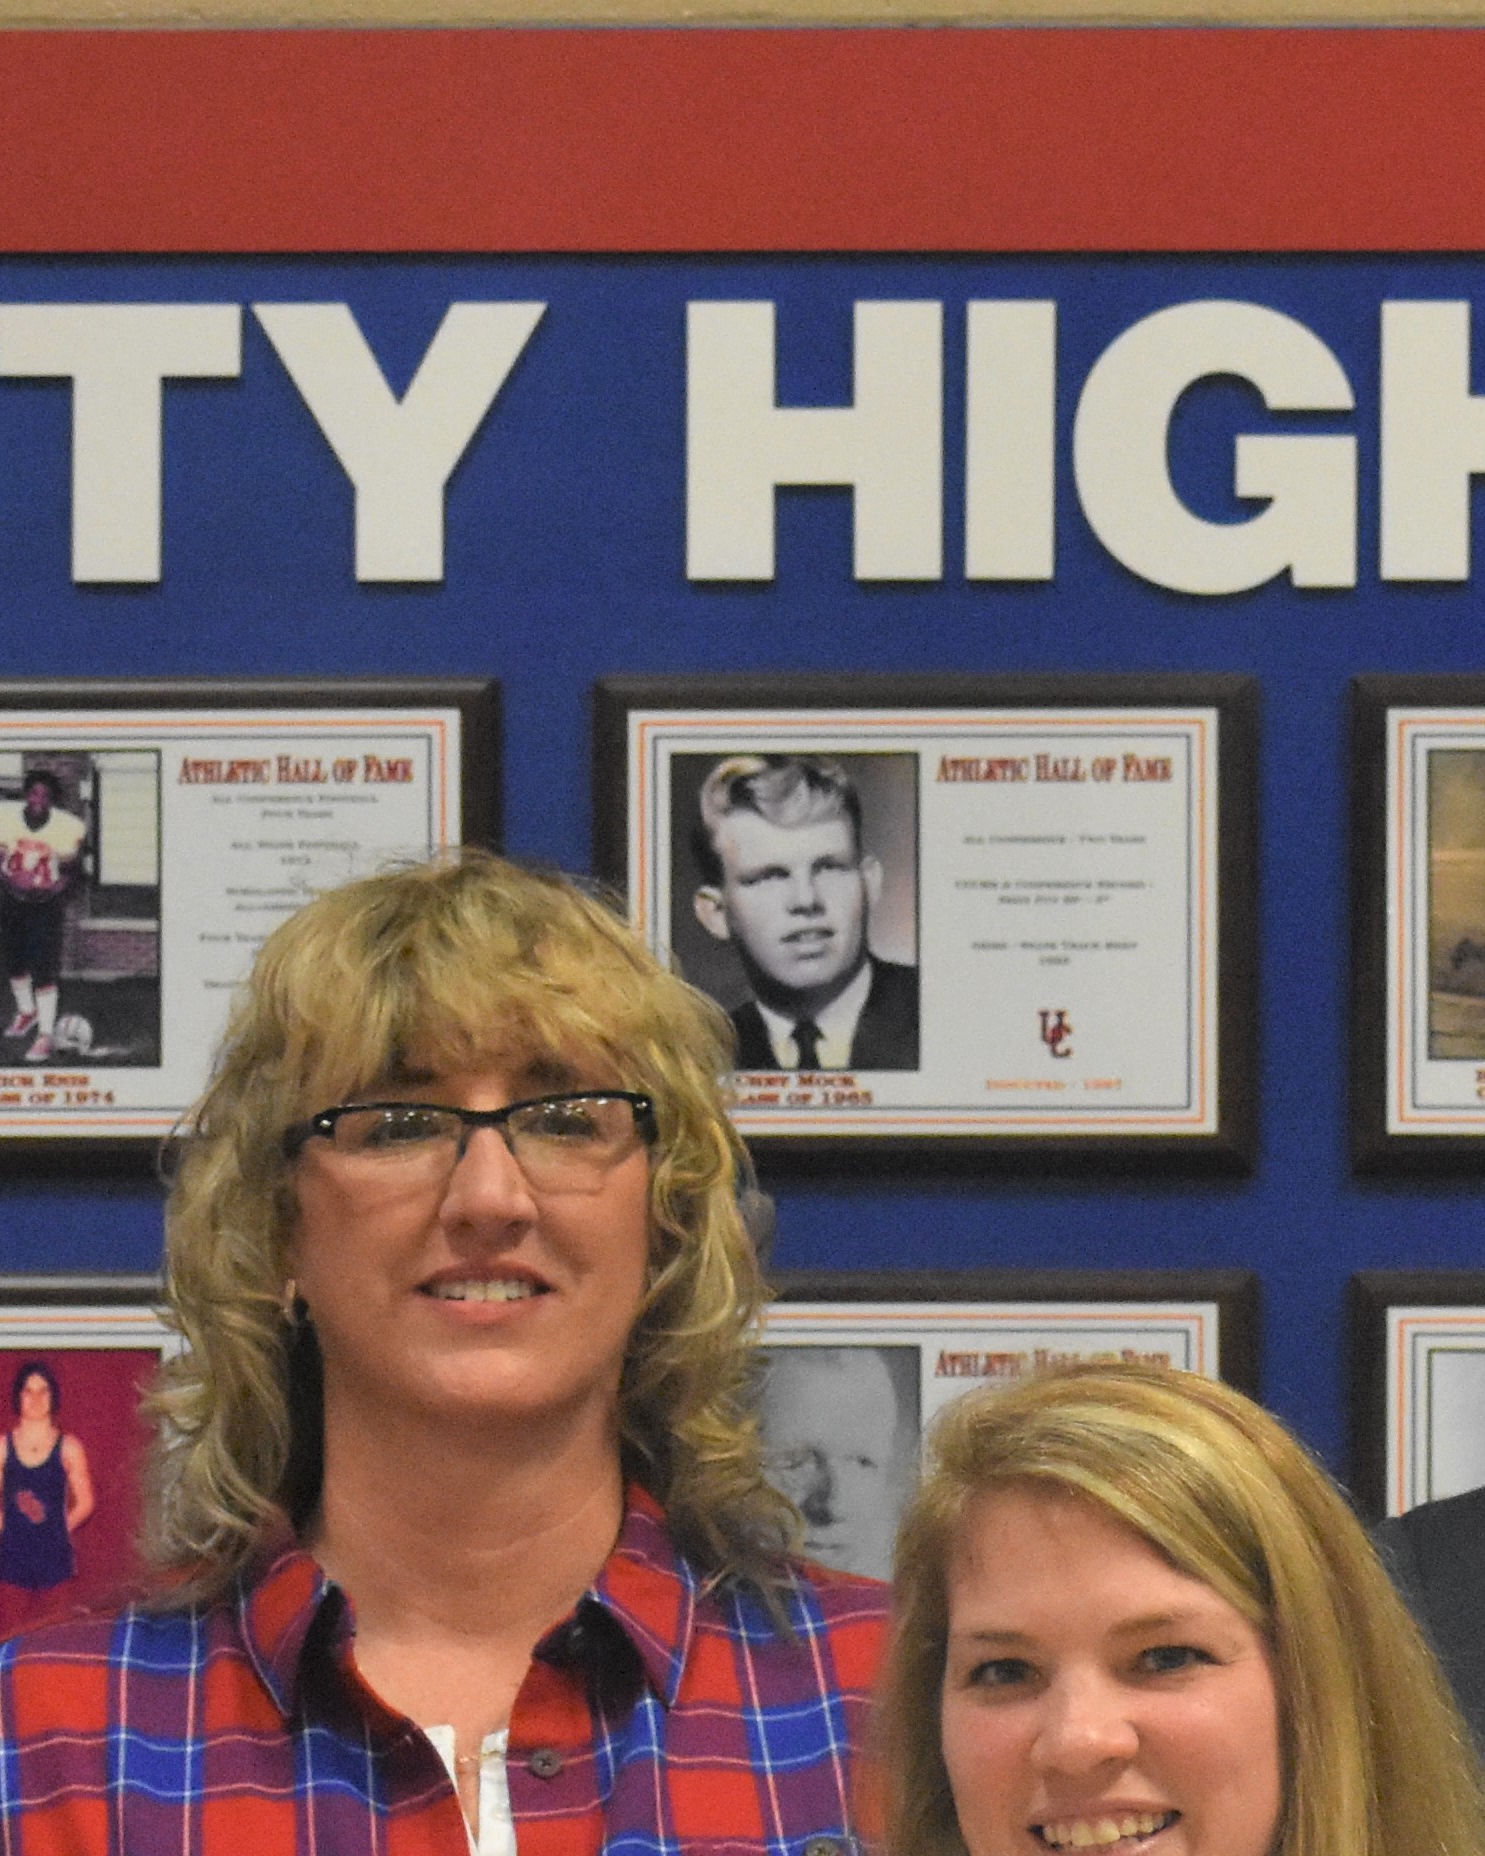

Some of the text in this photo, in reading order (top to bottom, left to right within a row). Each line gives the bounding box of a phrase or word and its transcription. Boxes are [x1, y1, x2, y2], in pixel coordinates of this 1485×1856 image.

[179, 756, 413, 785] ATHLETIC HALL OF FAME
[936, 754, 1172, 783] ATHLETIC HALL OF FAME
[30, 1091, 55, 1104] OF
